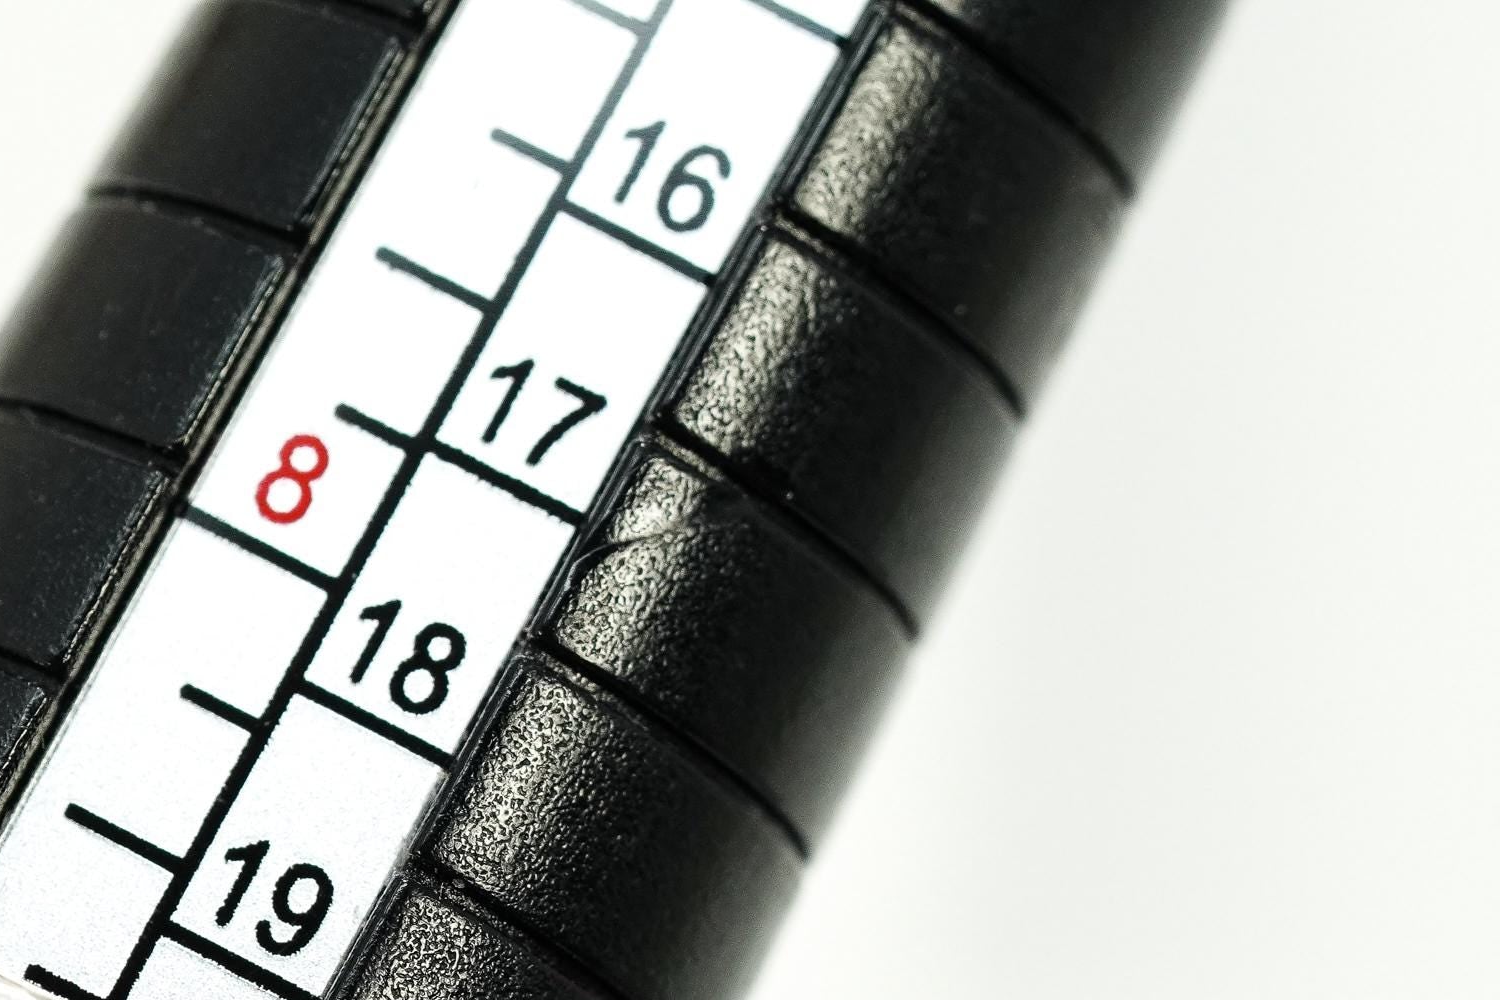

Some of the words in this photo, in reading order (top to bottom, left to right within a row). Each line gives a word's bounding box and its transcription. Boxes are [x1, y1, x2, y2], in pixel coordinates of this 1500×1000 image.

[615, 120, 731, 232] 16
[483, 359, 606, 466] 17
[255, 434, 329, 525] 8
[350, 600, 466, 715] 18
[215, 840, 334, 957] 19
